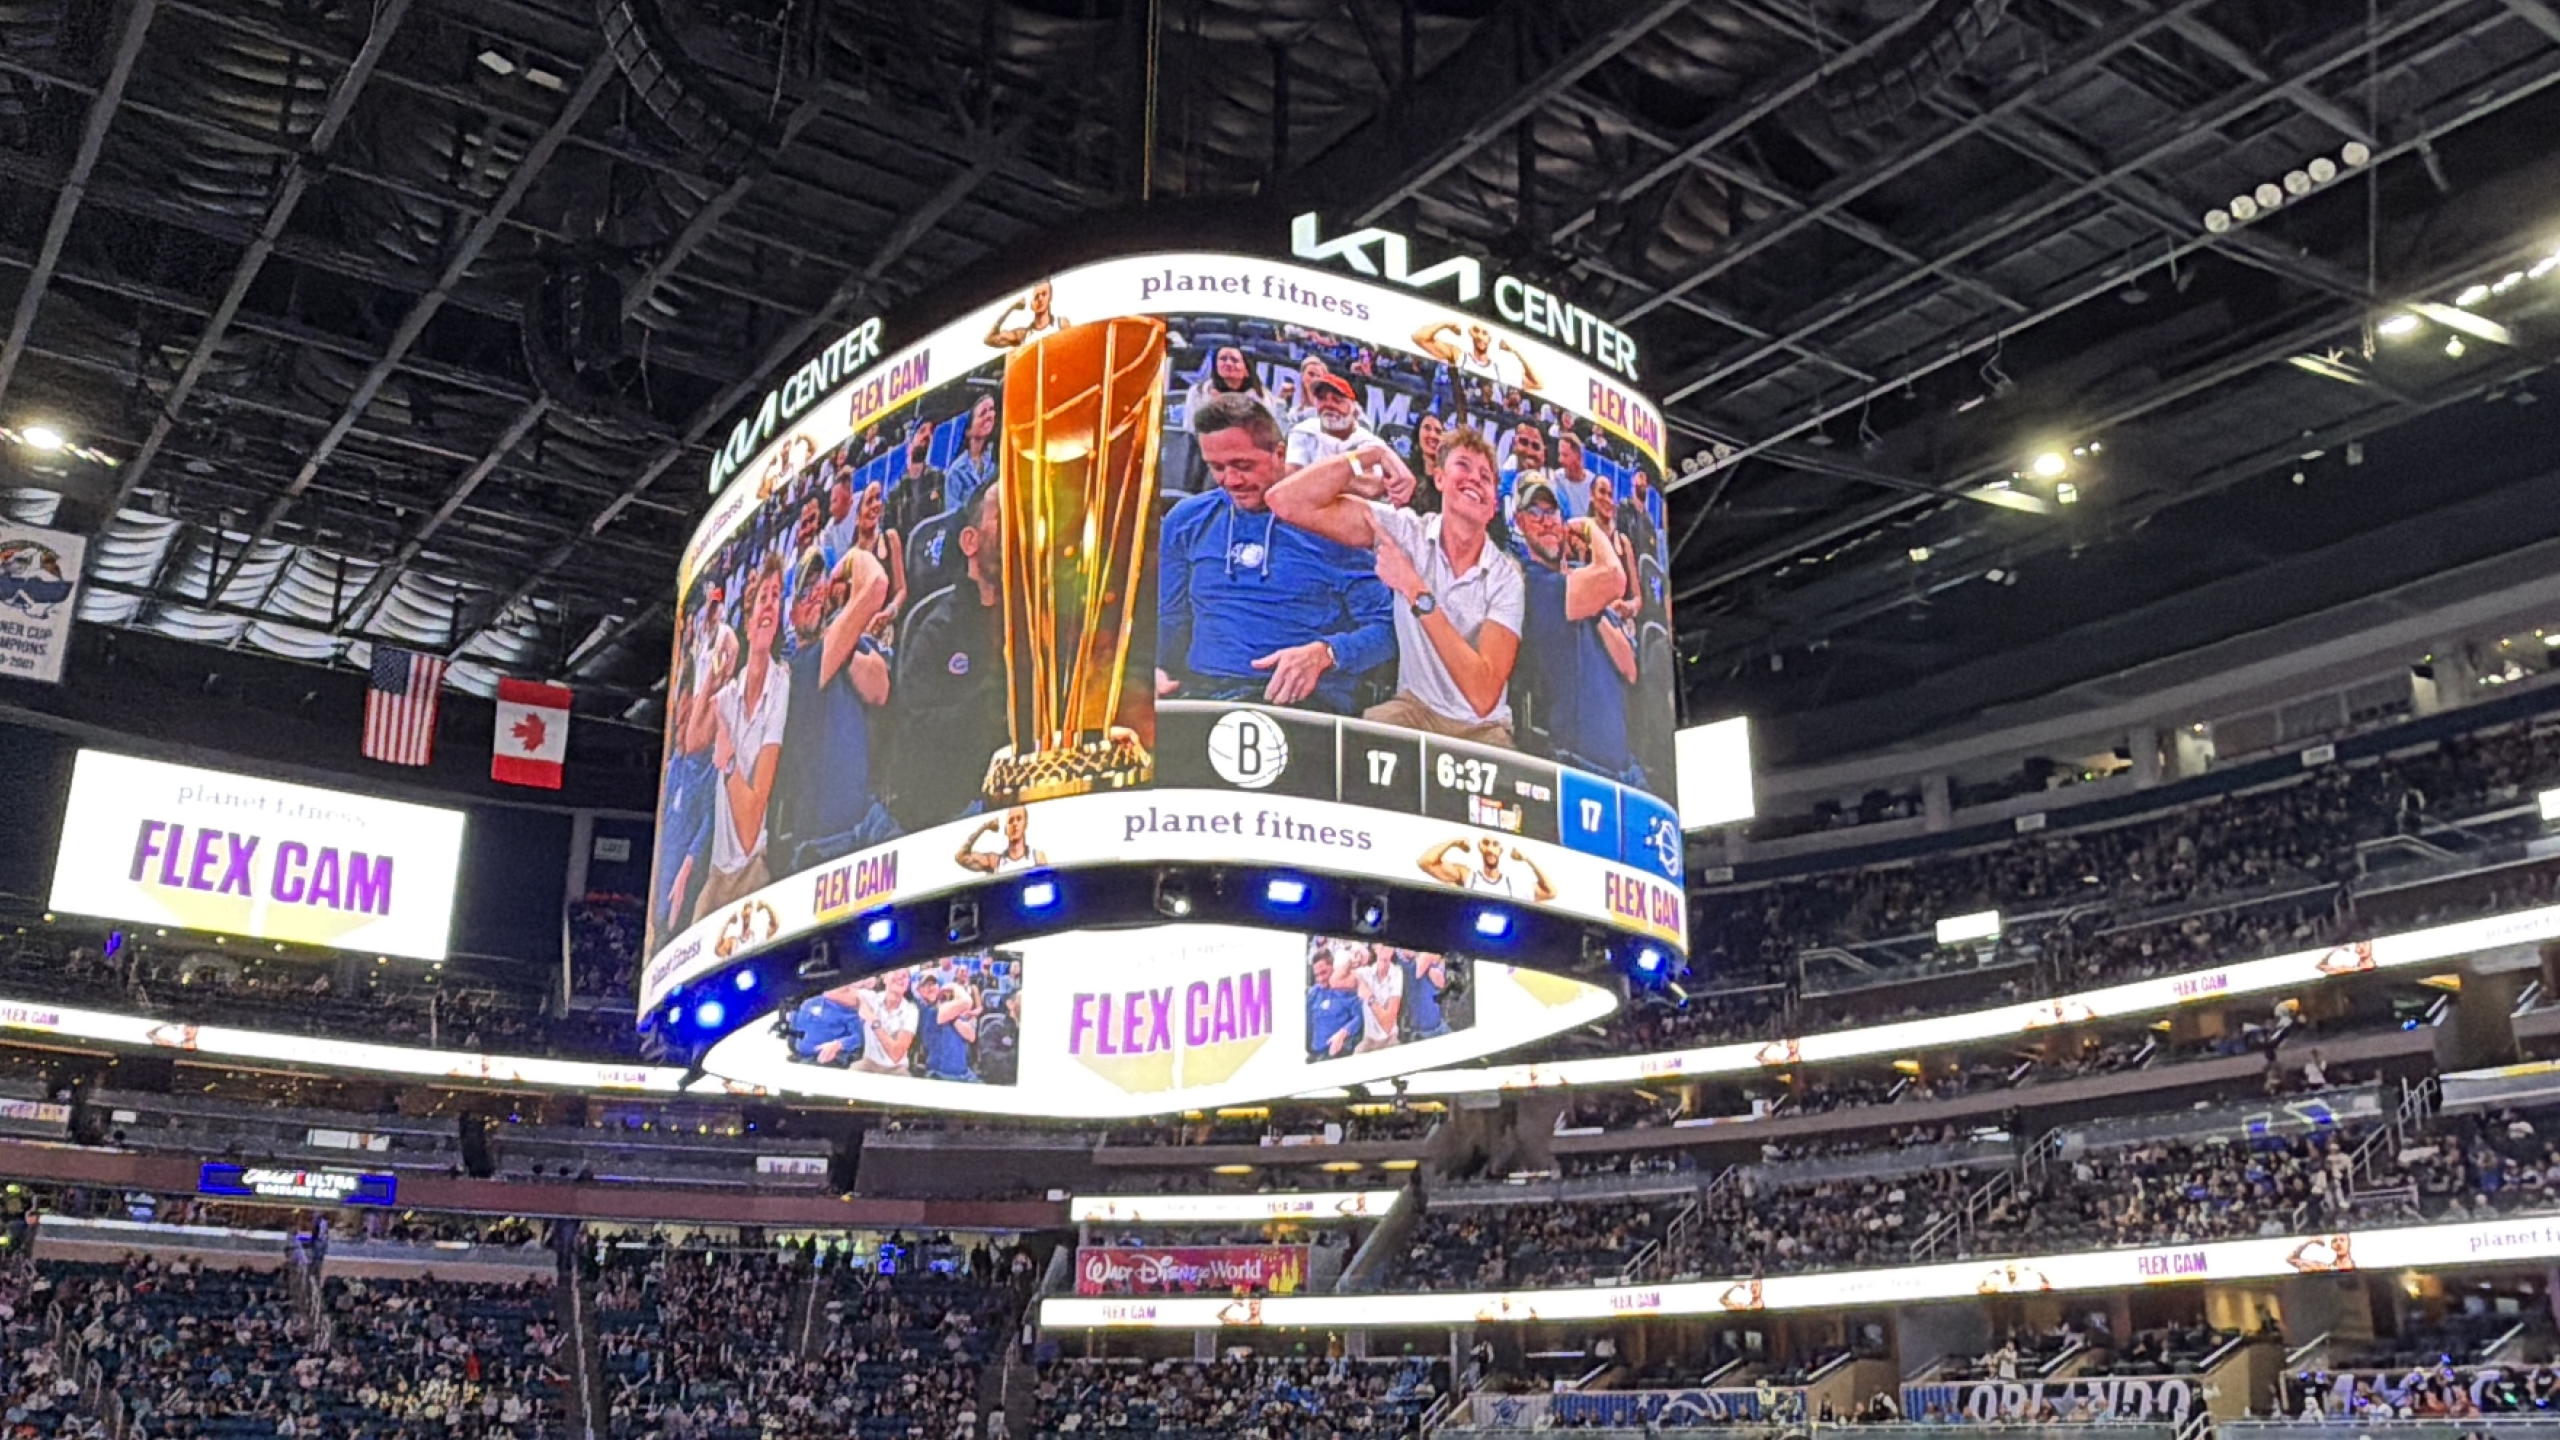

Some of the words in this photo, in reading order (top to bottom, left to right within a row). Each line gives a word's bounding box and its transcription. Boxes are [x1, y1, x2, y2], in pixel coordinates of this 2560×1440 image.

[1141, 269, 1252, 300] planet
[1262, 275, 1370, 322] fitness
[1291, 211, 1481, 302] KIA
[1495, 274, 1639, 382] CENTER
[707, 390, 778, 495] KIA
[780, 316, 882, 420] CENTER
[849, 371, 887, 427] FLEX
[888, 348, 931, 401] CAM
[1588, 377, 1629, 426] FLEX
[1631, 400, 1660, 447] CAM
[1238, 721, 1262, 776] B
[1367, 749, 1397, 786] 17
[1436, 752, 1499, 796] 6:37
[1124, 807, 1244, 841] planet
[1256, 811, 1373, 851] fitness
[1579, 797, 1603, 833] 17
[128, 818, 261, 898] FLEX
[270, 839, 394, 917] CAM
[813, 868, 851, 915] FLEX
[855, 849, 899, 910] CAM
[1605, 871, 1648, 921] FLEX
[1652, 884, 1680, 929] CAM
[1068, 986, 1174, 1055] FLEX
[1184, 967, 1273, 1048] CAM
[2172, 979, 2199, 997] FLEX
[2200, 973, 2229, 992] CAM
[31, 1011, 60, 1026] CAM
[1209, 1258, 1263, 1281] World
[2138, 1254, 2170, 1276] FLEX
[2173, 1250, 2209, 1275] CAM
